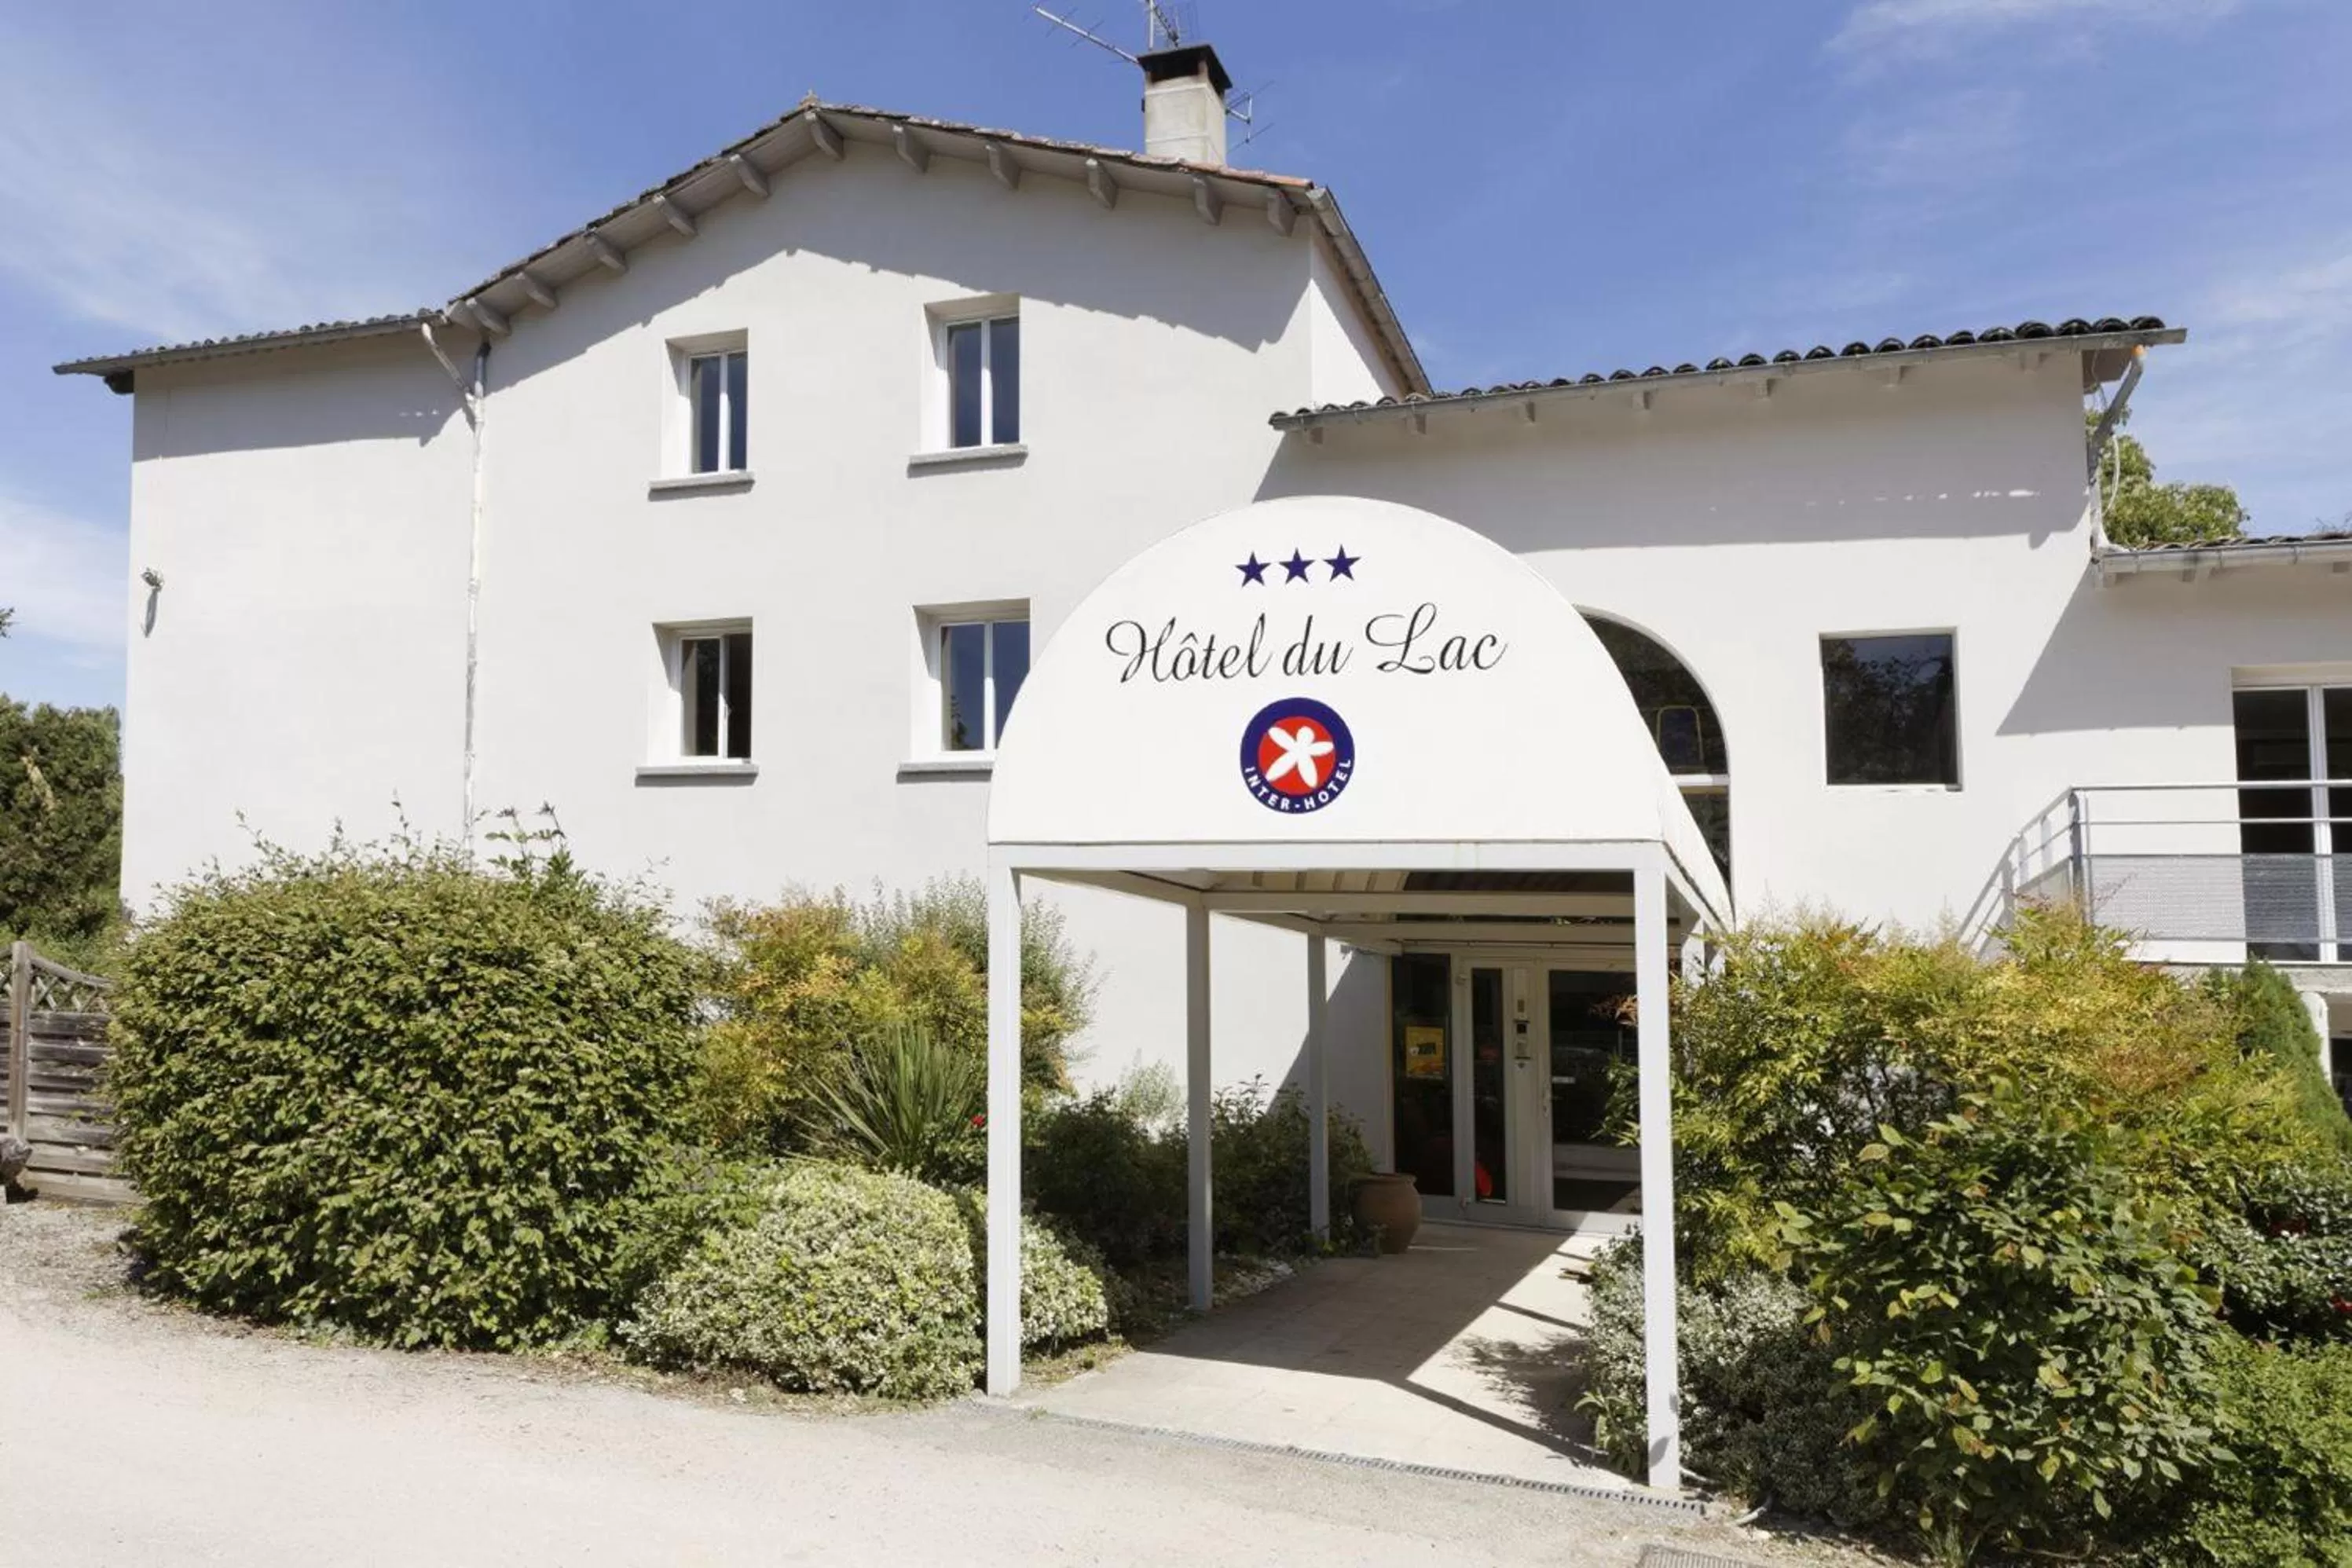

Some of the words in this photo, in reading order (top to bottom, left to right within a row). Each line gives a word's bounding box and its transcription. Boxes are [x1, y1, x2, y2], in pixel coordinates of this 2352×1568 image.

[1106, 613, 1273, 683] Hôtel
[1282, 614, 1354, 676] du
[1365, 602, 1508, 675] Lac
[1244, 758, 1351, 810] INTER-HOTEL
